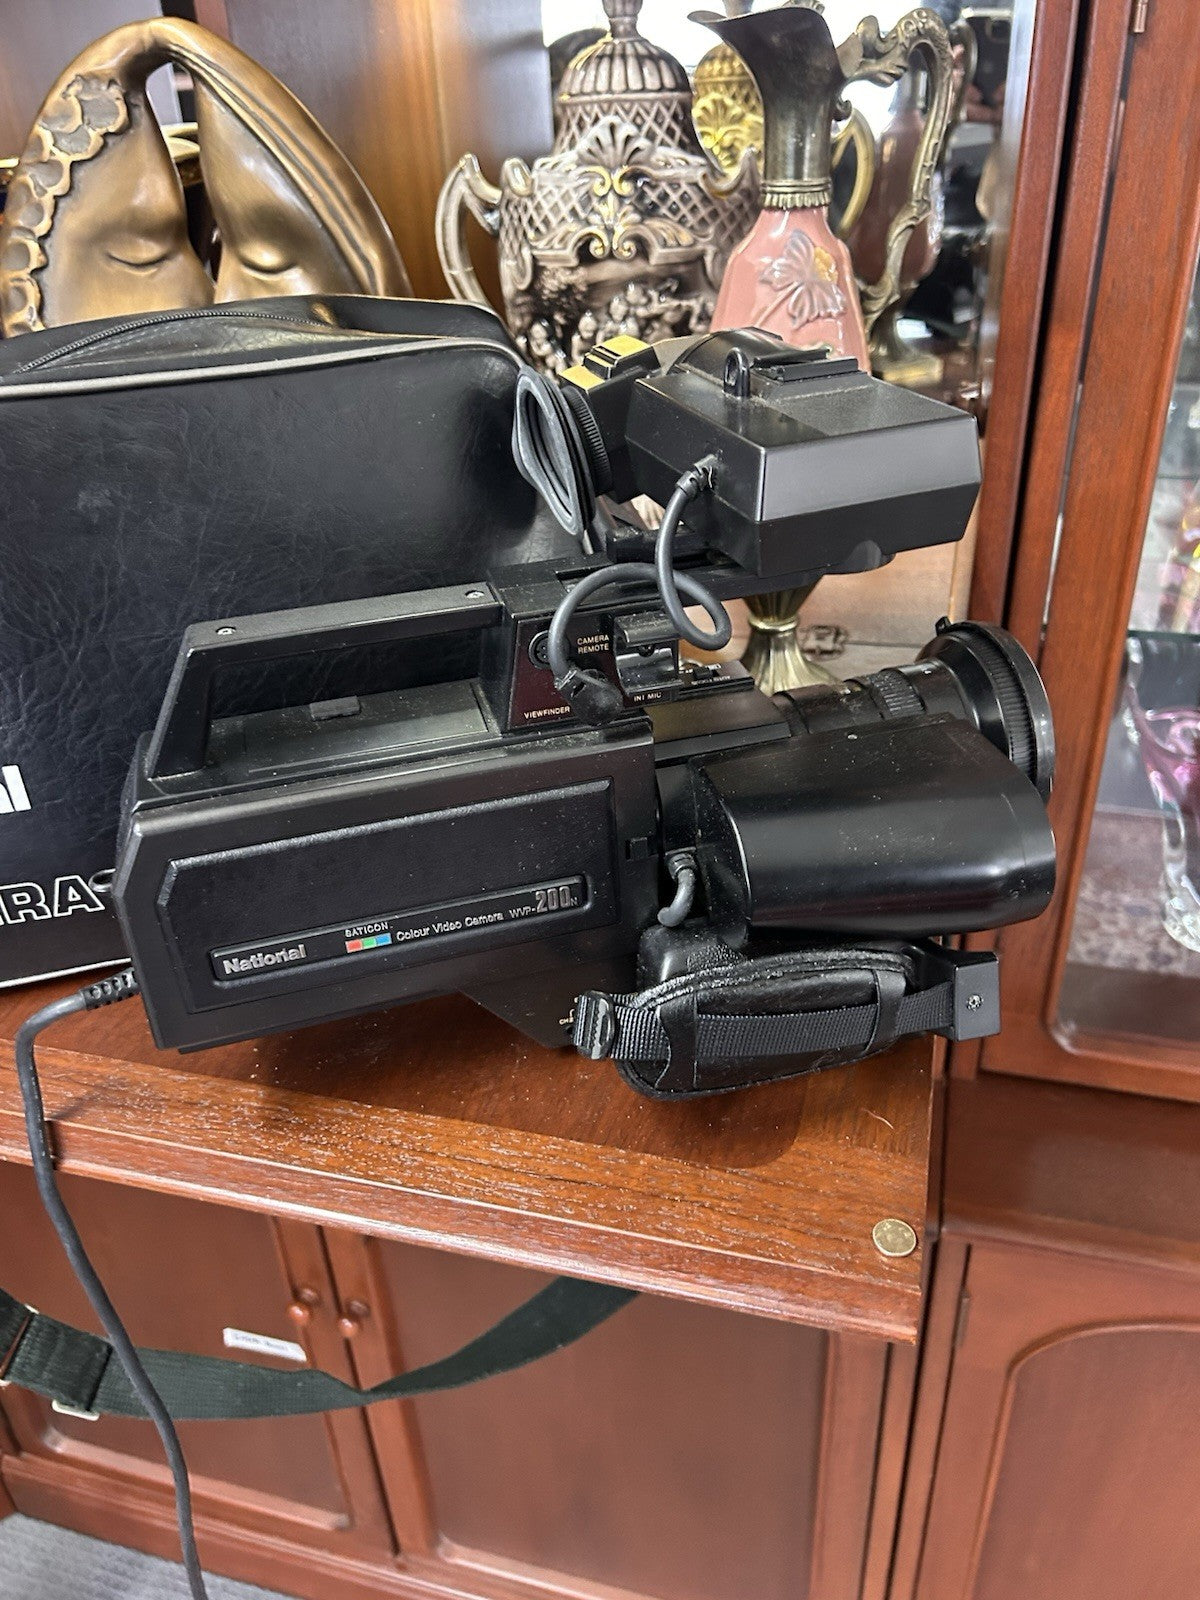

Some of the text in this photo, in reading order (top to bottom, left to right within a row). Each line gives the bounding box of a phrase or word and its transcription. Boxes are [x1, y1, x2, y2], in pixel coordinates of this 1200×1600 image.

[577, 634, 610, 645] CAMERA
[577, 643, 610, 655] REMOTE
[647, 692, 662, 700] MIC
[523, 705, 571, 720] VIEWFINDER
[0, 874, 106, 927] RA
[396, 925, 430, 942] Colour
[432, 920, 463, 935] Video
[464, 911, 505, 928] Camera
[222, 944, 308, 975] National
